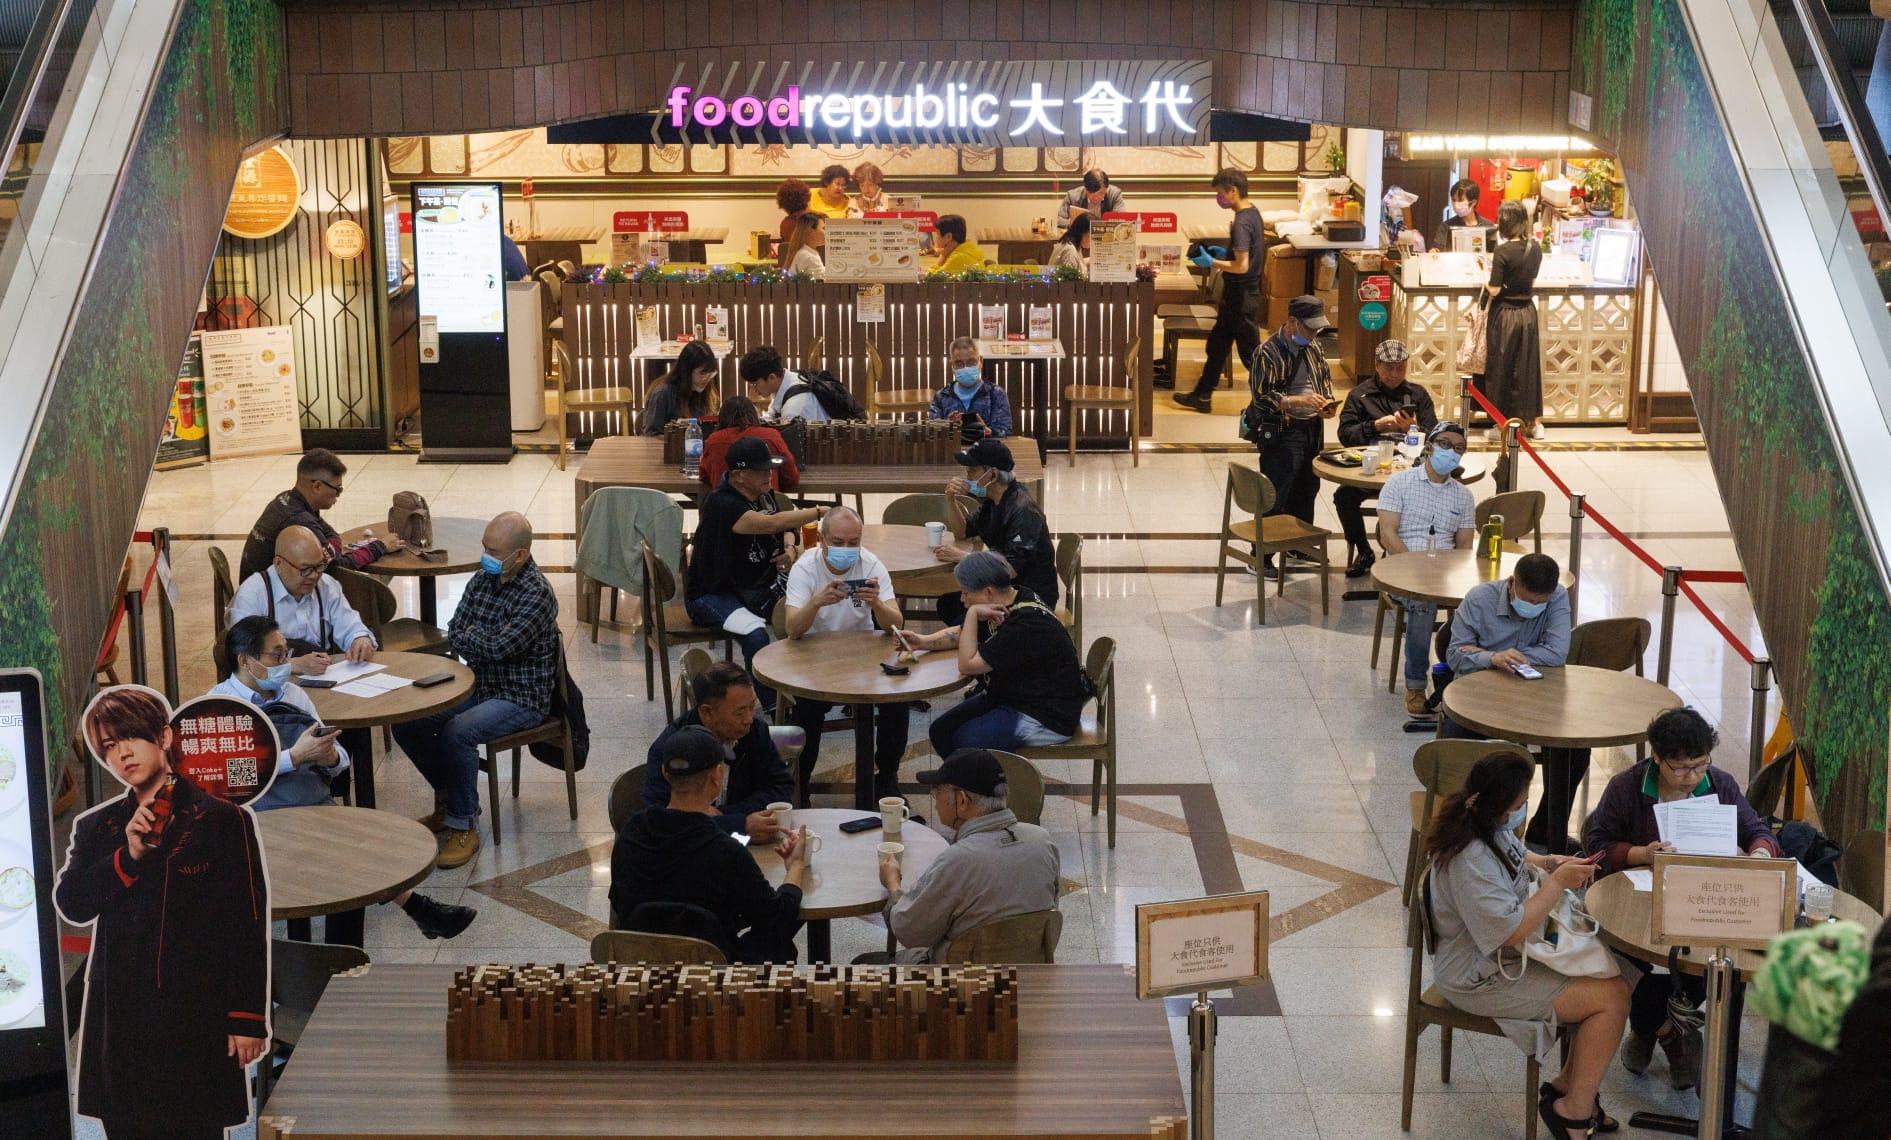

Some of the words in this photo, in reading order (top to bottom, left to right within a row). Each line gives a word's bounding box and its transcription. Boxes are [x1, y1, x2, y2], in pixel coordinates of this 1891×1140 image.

[1009, 80, 1197, 137] 大食代
[180, 714, 254, 735] 無糖體驗
[181, 735, 255, 756] 暢爽無比
[1701, 882, 1745, 893] 座位只供
[1687, 895, 1760, 907] 大食代食客使用
[1184, 936, 1222, 949] 座位只供
[1170, 944, 1234, 961] 大食代食客使用
